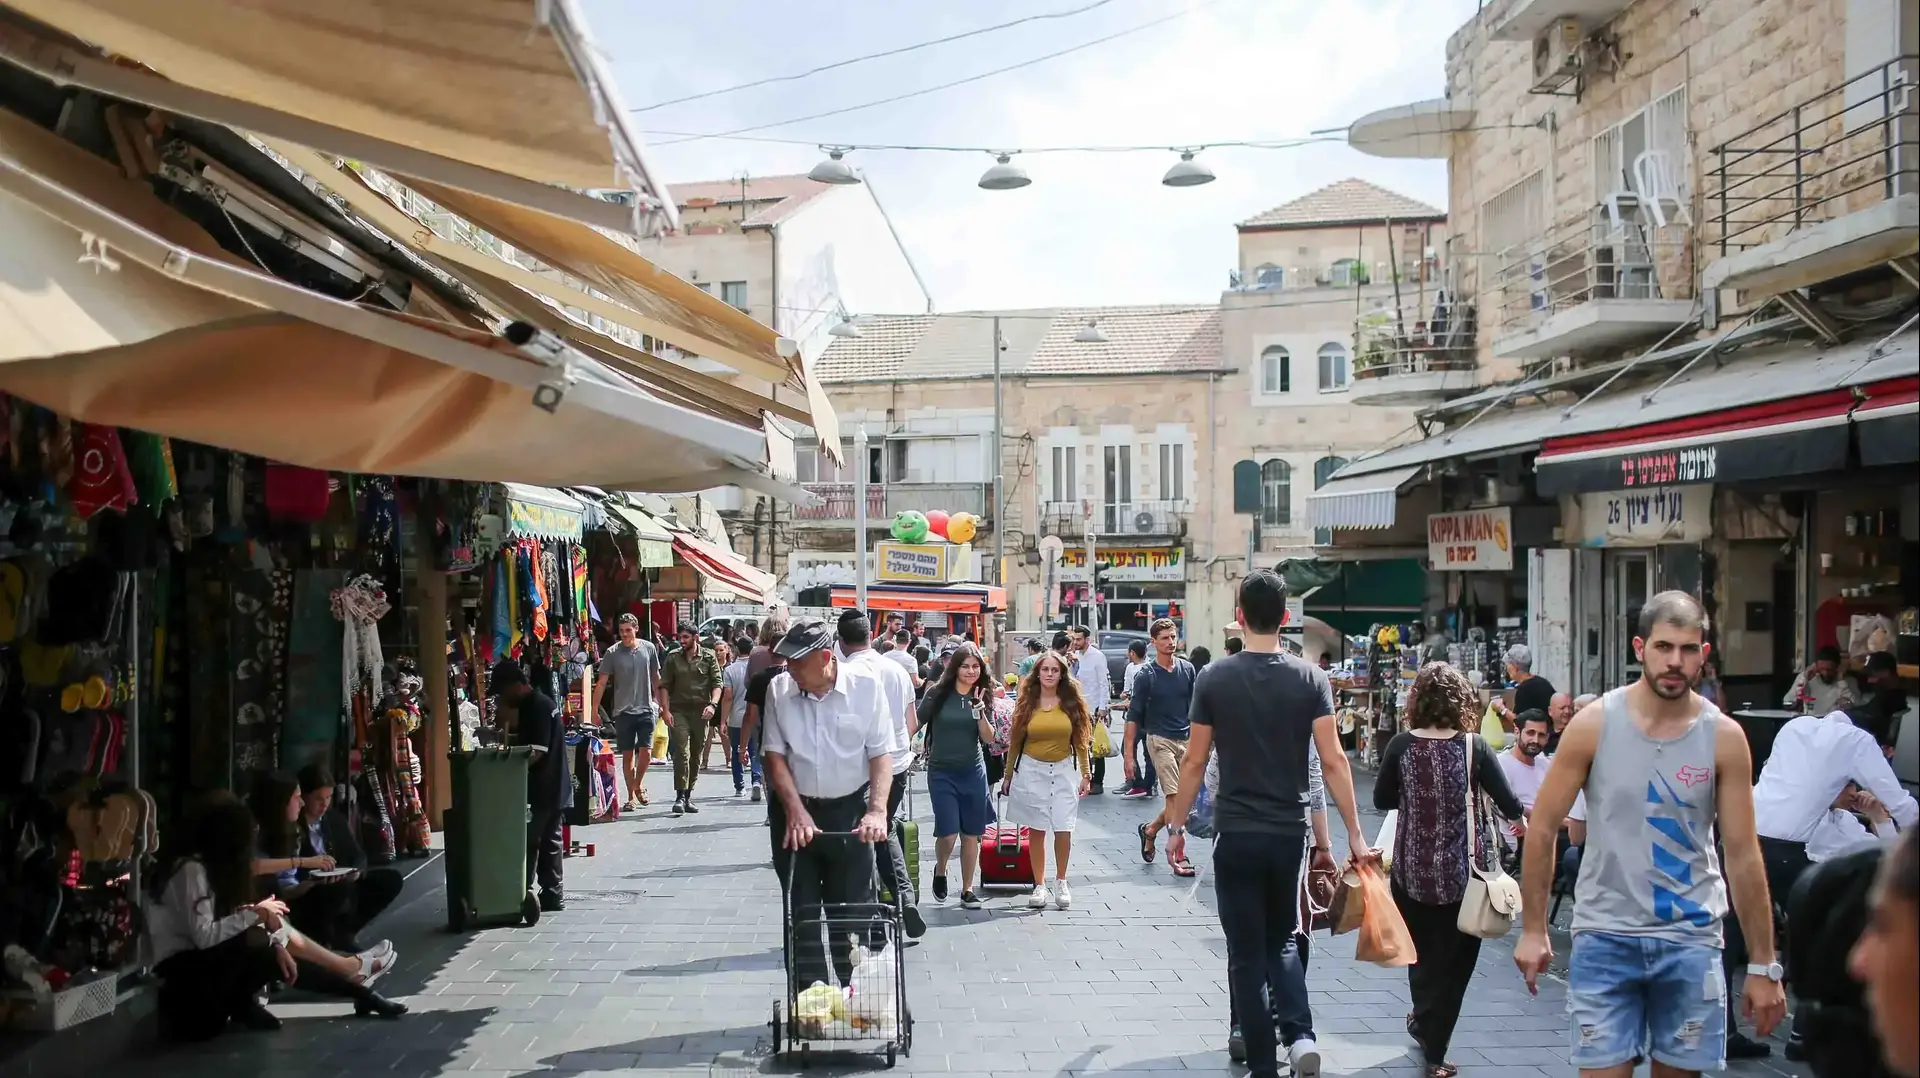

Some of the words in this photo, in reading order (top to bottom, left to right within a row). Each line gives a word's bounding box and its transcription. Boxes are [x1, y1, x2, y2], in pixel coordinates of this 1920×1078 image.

[1621, 456, 1634, 486] בר
[1637, 451, 1676, 484] אספרסו
[1678, 445, 1716, 481] ארומה
[1608, 499, 1620, 525] 26
[1626, 494, 1650, 533] ציון
[1430, 516, 1461, 544] KIPPA
[1464, 513, 1493, 541] MAN
[887, 561, 910, 572] שלך?
[888, 550, 915, 561] מספרי
[917, 554, 937, 564] מהם
[1151, 551, 1180, 572] שוק
[912, 564, 936, 576] המזל
